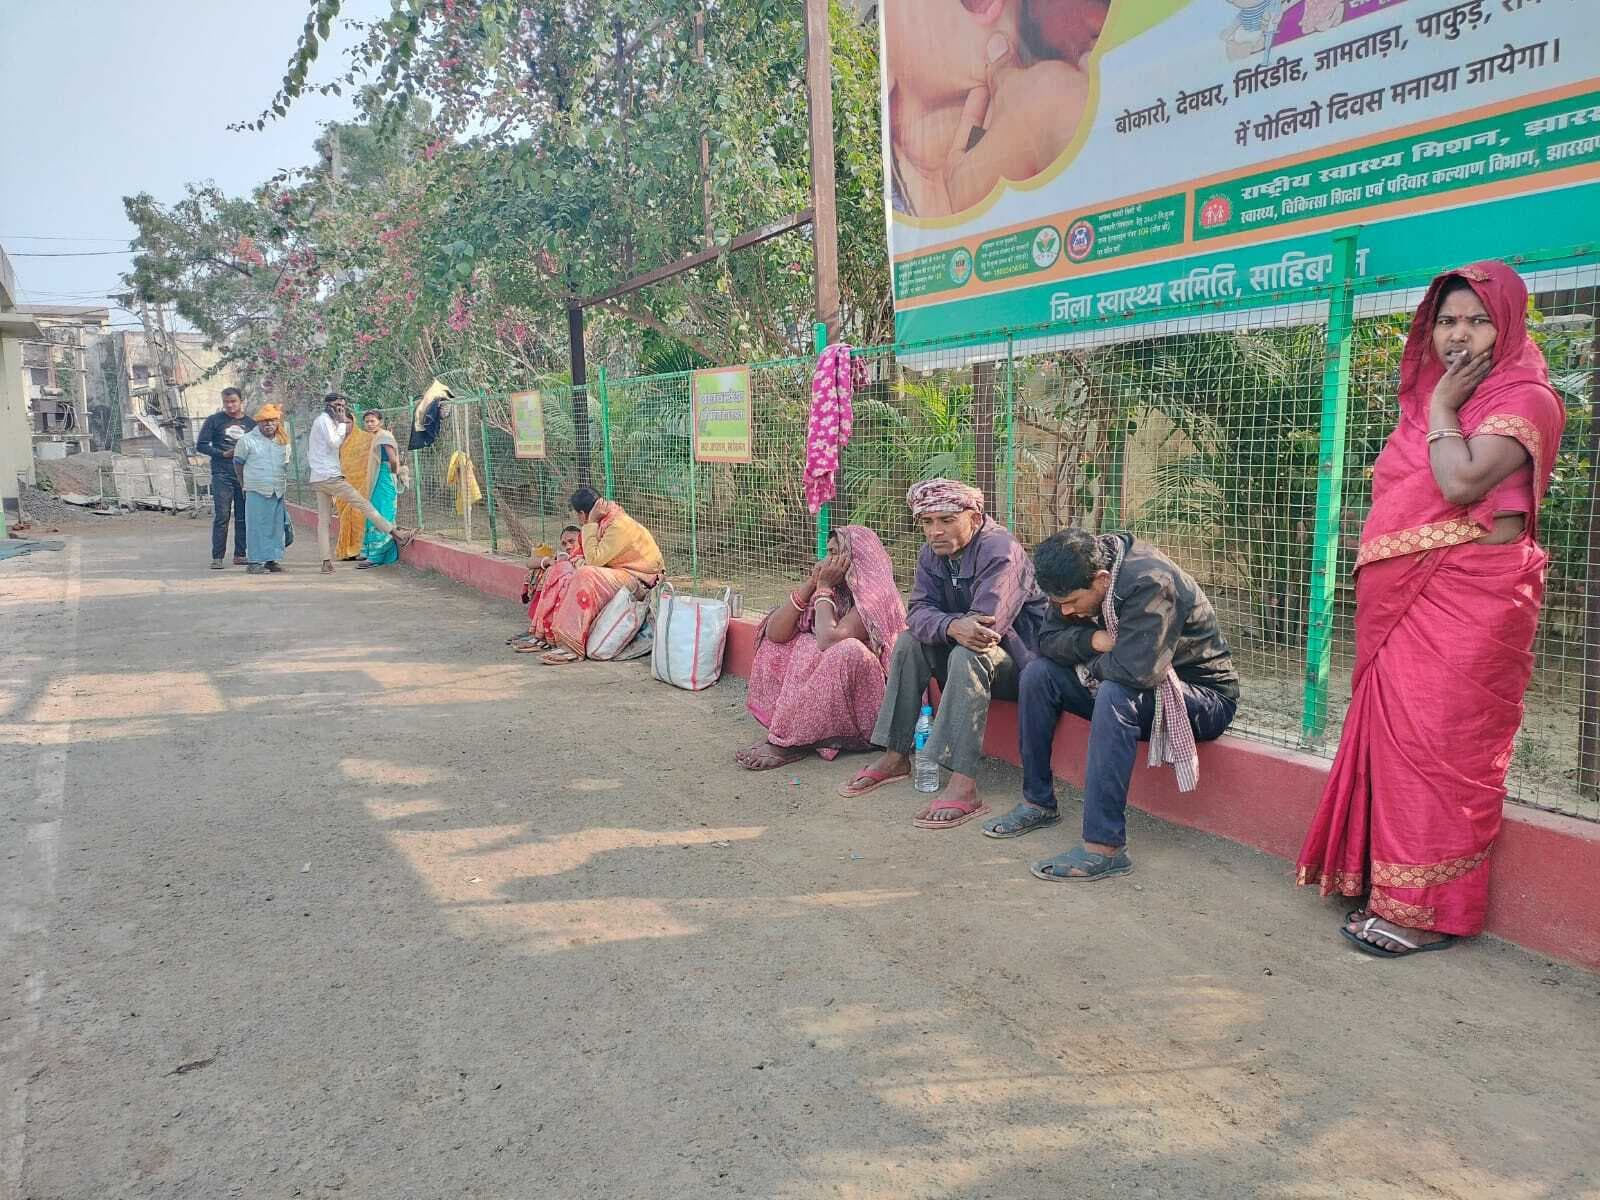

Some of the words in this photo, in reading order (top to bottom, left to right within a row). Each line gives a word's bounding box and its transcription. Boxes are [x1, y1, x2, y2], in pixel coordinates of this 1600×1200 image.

[1115, 98, 1170, 134] बोकारो,
[1176, 84, 1228, 115] देवघर,
[1233, 56, 1309, 98] गिरिडीह,
[1314, 25, 1409, 72] जामताड़ा,
[1416, 0, 1492, 40] पाकुड़,
[1235, 120, 1251, 146] में
[1254, 101, 1323, 142] पोलियो
[1327, 88, 1385, 123] दिवस
[1390, 66, 1460, 104] मनाया
[1240, 205, 1278, 224] स्वास्थ्य,
[1281, 192, 1328, 216] चिकित्सा
[1330, 185, 1362, 205] शिक्षा
[1365, 178, 1385, 197] एवं
[1387, 173, 1430, 193] परिवार
[1431, 160, 1487, 182] कल्याण
[1488, 149, 1541, 173] विभाग,
[1241, 173, 1312, 200] राष्ट्रीय
[1318, 152, 1404, 182] स्वास्थ्य
[1411, 128, 1512, 162] मिशन,
[1050, 292, 1092, 321] जिला
[1096, 282, 1163, 315] स्वास्थ्य
[1168, 263, 1242, 302] समिति,
